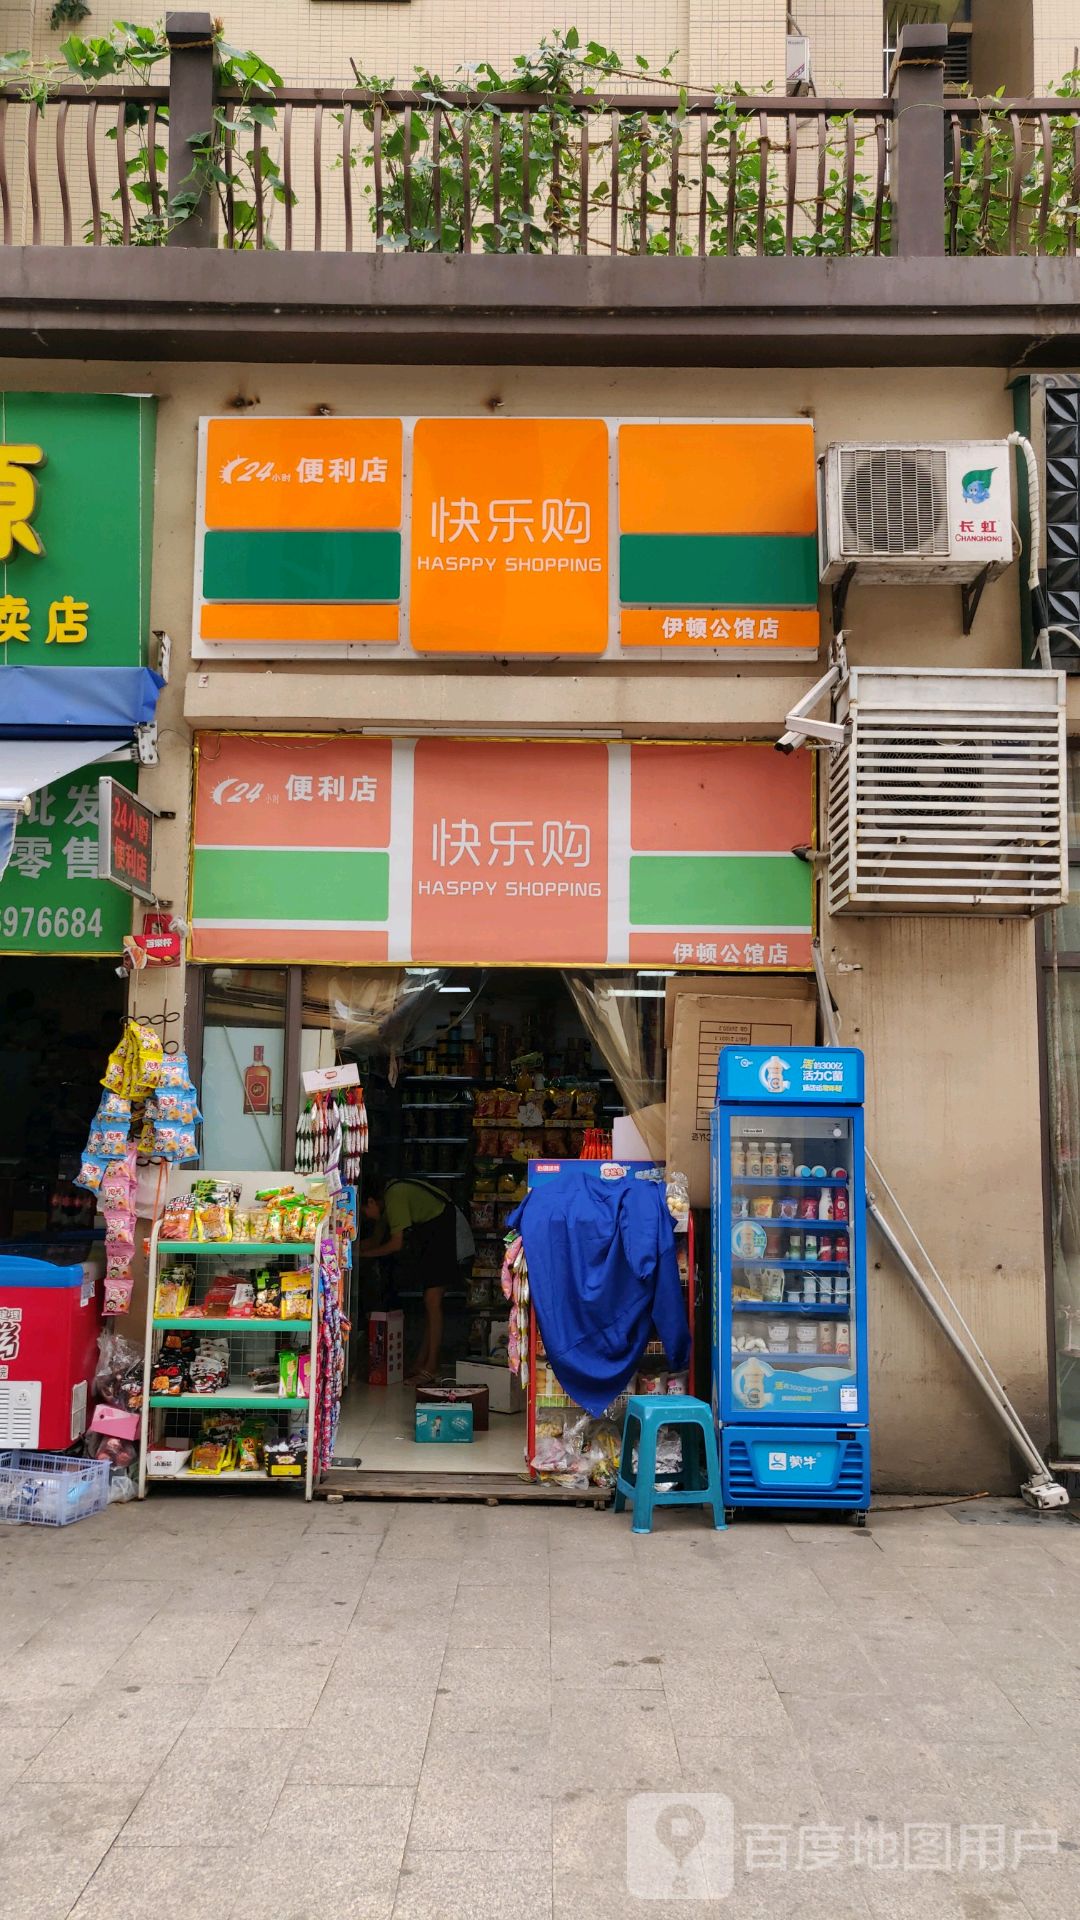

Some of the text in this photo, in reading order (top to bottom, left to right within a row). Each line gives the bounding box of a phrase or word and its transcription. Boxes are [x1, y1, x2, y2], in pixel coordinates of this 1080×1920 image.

[296, 456, 388, 483] 便利店
[431, 496, 591, 544] 快乐购
[959, 520, 997, 533] 长虹
[417, 556, 602, 572] HASPPY SHOPPING
[662, 616, 779, 639] 伊顿公馆店
[285, 774, 378, 802] 便利店
[432, 818, 591, 867] 快乐购
[9, 836, 99, 880] 零售
[418, 881, 602, 897] HASPPY SHOPPING
[0, 906, 103, 938] 976684
[673, 942, 788, 964] 伊顿公馆店
[789, 1454, 817, 1470] 蒙牛
